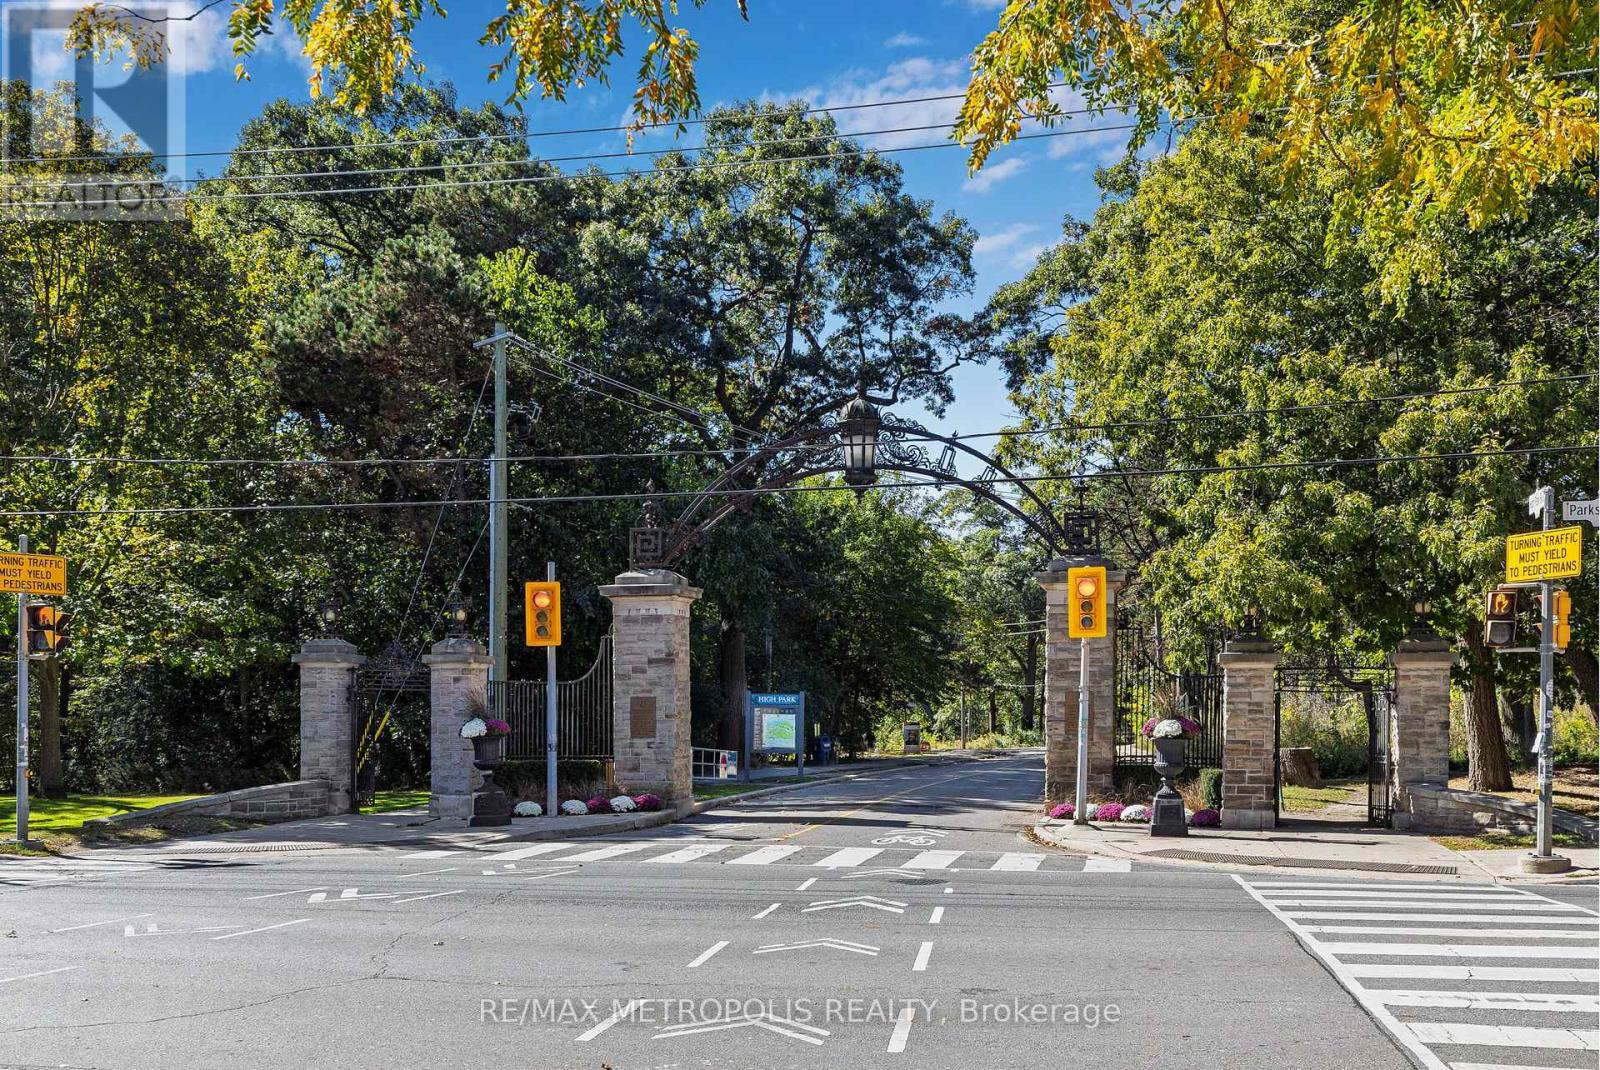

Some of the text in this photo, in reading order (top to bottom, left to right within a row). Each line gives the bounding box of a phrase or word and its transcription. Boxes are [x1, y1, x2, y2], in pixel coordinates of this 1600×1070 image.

[1510, 532, 1578, 550] TURNING TRAFFIC
[1519, 547, 1567, 563] MUST YIELD
[28, 557, 63, 569] TRAFFIC
[1510, 560, 1577, 577] TO PEDESTRIANS
[0, 568, 52, 580] MUST YIELD
[4, 579, 62, 591] PEDESTRIANS
